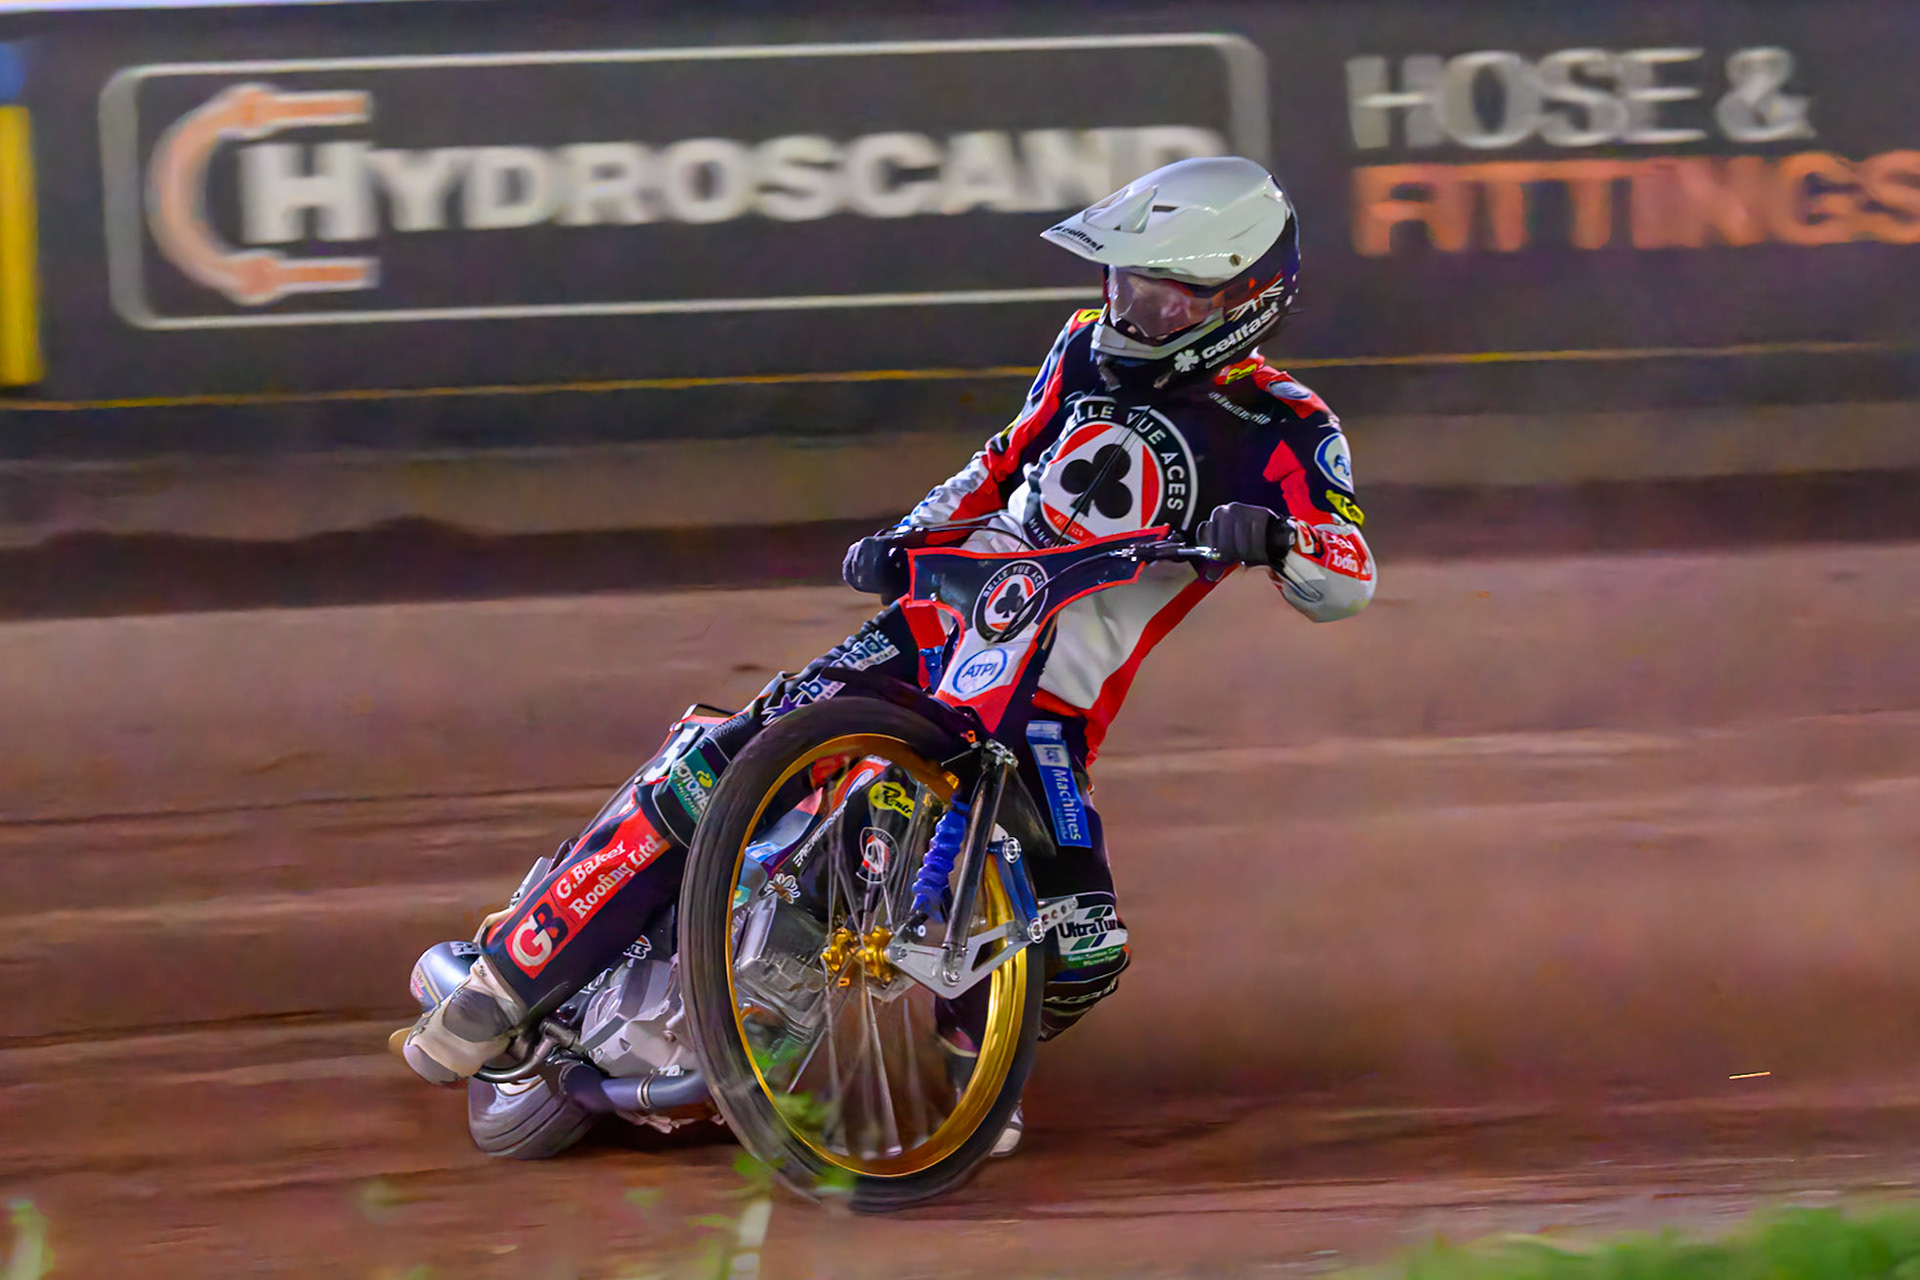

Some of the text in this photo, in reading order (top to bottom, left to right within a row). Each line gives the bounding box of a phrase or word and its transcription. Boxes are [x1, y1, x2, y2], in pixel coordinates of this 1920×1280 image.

[1345, 46, 1816, 149] HOSE &
[1126, 411, 1167, 445] VUE
[1160, 452, 1186, 511] ACES
[961, 662, 999, 678] ATPI
[1051, 768, 1082, 840] Machines
[556, 840, 627, 899] G.Baker
[568, 863, 636, 919] Roofing
